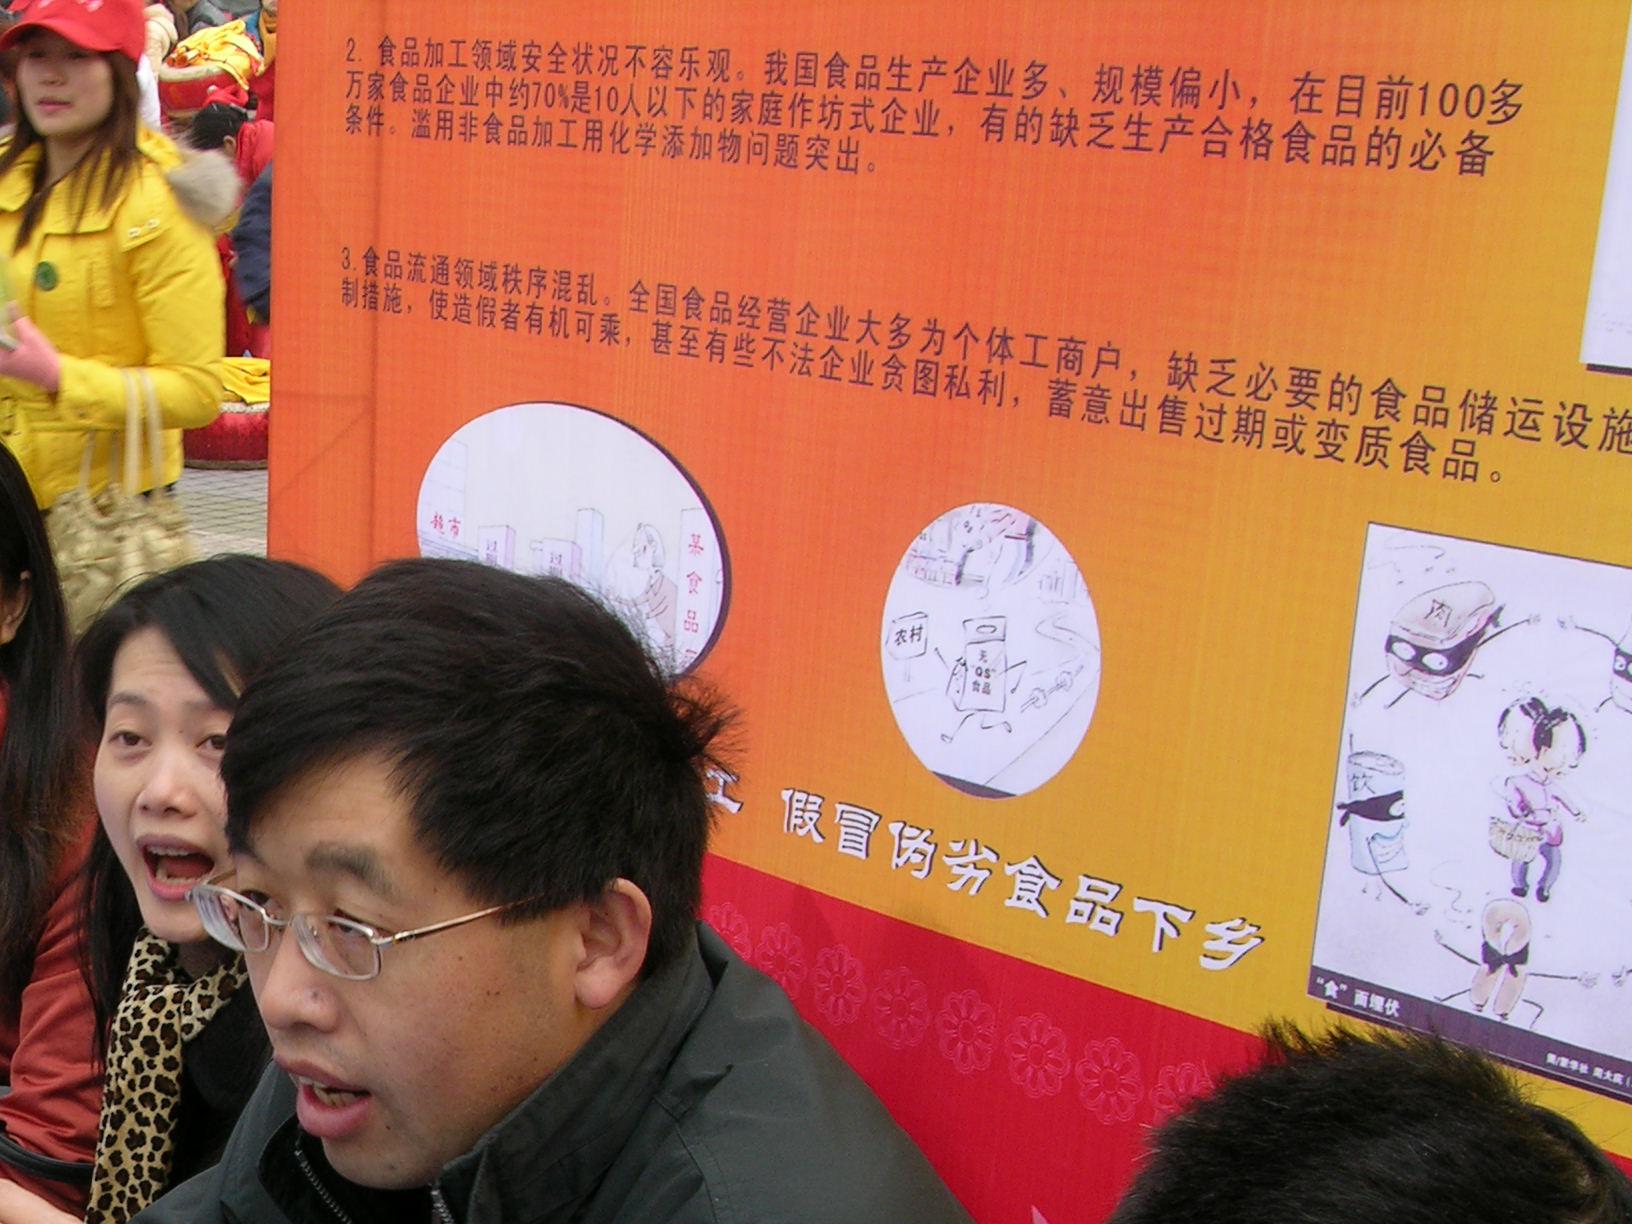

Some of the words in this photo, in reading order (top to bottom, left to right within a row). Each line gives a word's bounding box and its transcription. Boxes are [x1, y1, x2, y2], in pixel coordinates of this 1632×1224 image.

[894, 625, 924, 646] 农村
[781, 786, 1266, 973] 假冒伪劣食品下乡
